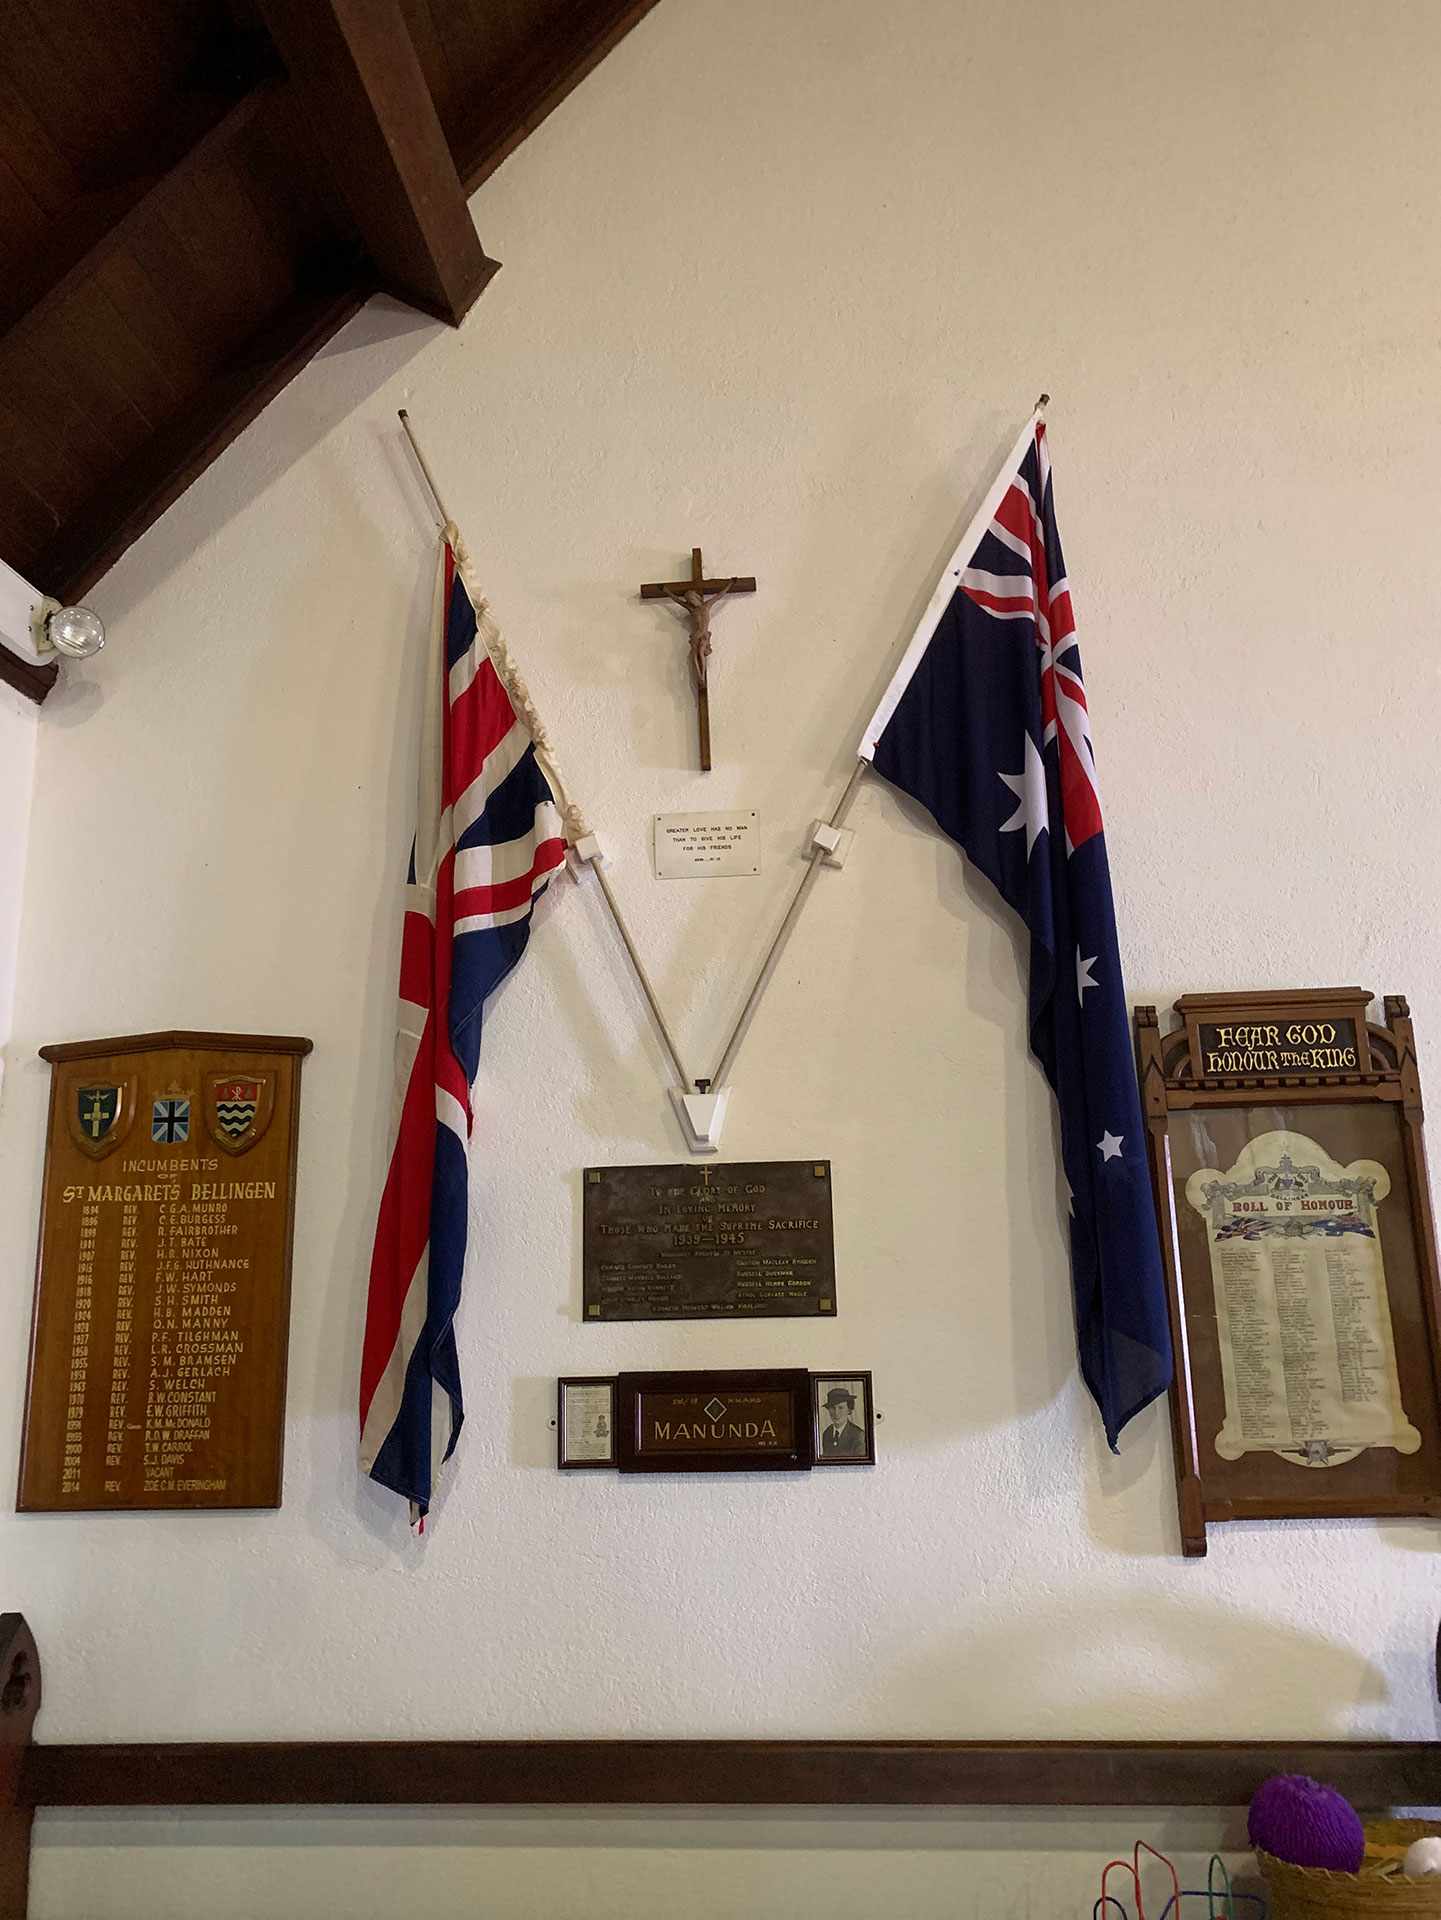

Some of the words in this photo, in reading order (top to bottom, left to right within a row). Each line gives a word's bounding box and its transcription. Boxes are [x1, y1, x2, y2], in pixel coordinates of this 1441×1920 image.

[1216, 1025, 1281, 1050] FEAR
[1286, 1023, 1336, 1045] GOD
[1207, 1050, 1280, 1072] HONOUR
[1310, 1047, 1356, 1068] KING
[122, 1159, 218, 1172] INCUMBENTS
[191, 1182, 276, 1200] BELLINGEN
[690, 1186, 721, 1196] GLORY
[727, 1186, 739, 1195] OF
[746, 1184, 766, 1194] GOD
[123, 1205, 140, 1214] REV.
[192, 1203, 228, 1213] MUNRO
[659, 1205, 671, 1215] IN
[677, 1205, 711, 1215] LOVING
[718, 1203, 756, 1213] MEMORY
[1232, 1201, 1268, 1213] ROLL
[1275, 1201, 1293, 1211] OF
[1300, 1199, 1357, 1211] HONOUR.
[122, 1216, 139, 1225] REV.
[180, 1214, 226, 1224] BURGESS
[122, 1227, 139, 1237] REV.
[169, 1225, 239, 1236] FAIRBROTHER
[601, 1224, 631, 1235] THOSE
[637, 1224, 658, 1234] WHO
[664, 1223, 691, 1233] MADE
[695, 1222, 713, 1232] THE
[720, 1221, 763, 1231] SUPREME
[768, 1219, 819, 1230] SACRIFICE
[121, 1238, 139, 1248] REV.
[180, 1236, 207, 1247] BATE
[120, 1250, 137, 1260] REV.
[182, 1248, 219, 1258] NIXON
[119, 1262, 136, 1272] REV.
[185, 1259, 250, 1270] HUTHNANCE
[77, 1274, 93, 1285] 1916
[119, 1273, 136, 1283] REV.
[181, 1271, 214, 1282] HART
[118, 1285, 135, 1295] REV.
[182, 1282, 237, 1293] SYMONDS
[117, 1297, 134, 1307] REV.
[181, 1294, 219, 1306] SMITH
[116, 1309, 133, 1319] REV.
[181, 1306, 231, 1317] MADDEN
[115, 1321, 133, 1332] REV.
[182, 1318, 229, 1329] MANNY
[115, 1333, 132, 1343] REV.
[177, 1330, 239, 1342] TILGHMAN
[114, 1344, 132, 1355] REV.
[175, 1343, 244, 1354] CROSSMAN
[113, 1357, 131, 1367] REV.
[179, 1354, 237, 1366] BRAMSEN
[112, 1368, 130, 1379] REV.
[177, 1366, 231, 1377] GERLACH
[111, 1381, 129, 1392] REV.
[149, 1380, 160, 1391] S.
[164, 1378, 205, 1390] WELCH
[110, 1393, 128, 1404] REV.
[167, 1391, 217, 1403] CONSTANT
[110, 1405, 127, 1418] REV.
[165, 1404, 207, 1417] GRIFFITH
[109, 1419, 126, 1430] REV.
[654, 1419, 777, 1440] MANUNDA
[161, 1441, 194, 1453] CARROL
[161, 1454, 185, 1465] DAVIS
[145, 1467, 175, 1478] VACANT
[143, 1480, 160, 1492] ZOE
[177, 1479, 227, 1491] EVERINGHAM
